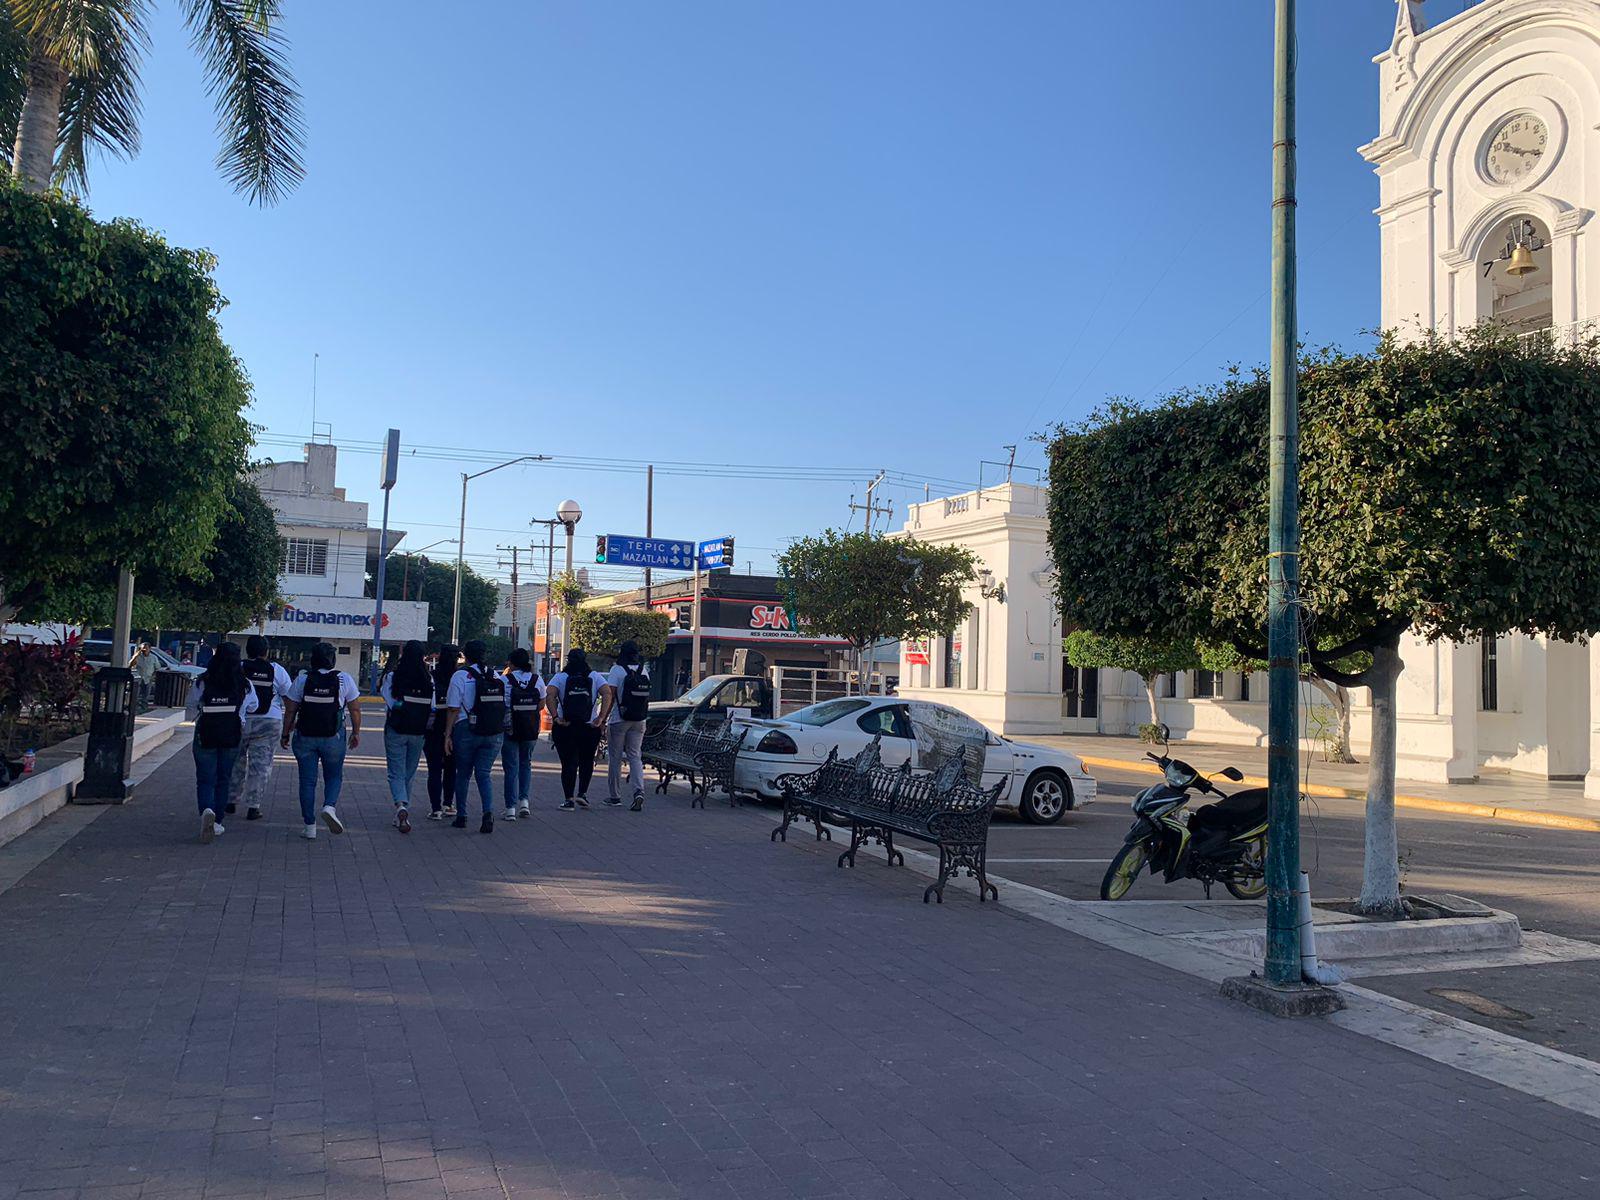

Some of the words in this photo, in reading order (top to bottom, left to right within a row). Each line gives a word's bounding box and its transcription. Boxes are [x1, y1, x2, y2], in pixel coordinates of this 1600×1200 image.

[1511, 123, 1521, 134] 12
[1524, 121, 1529, 131] 1
[1533, 124, 1540, 134] 2
[1501, 130, 1508, 141] 11
[1538, 134, 1545, 145] 3
[1493, 142, 1503, 152] 10
[1490, 155, 1496, 165] 9
[1525, 160, 1532, 171] 5
[1494, 164, 1501, 175] 8
[1503, 169, 1509, 179] 7
[628, 541, 665, 552] TEPIC
[622, 552, 669, 564] MAZATLAN
[268, 605, 371, 626] tibanamex
